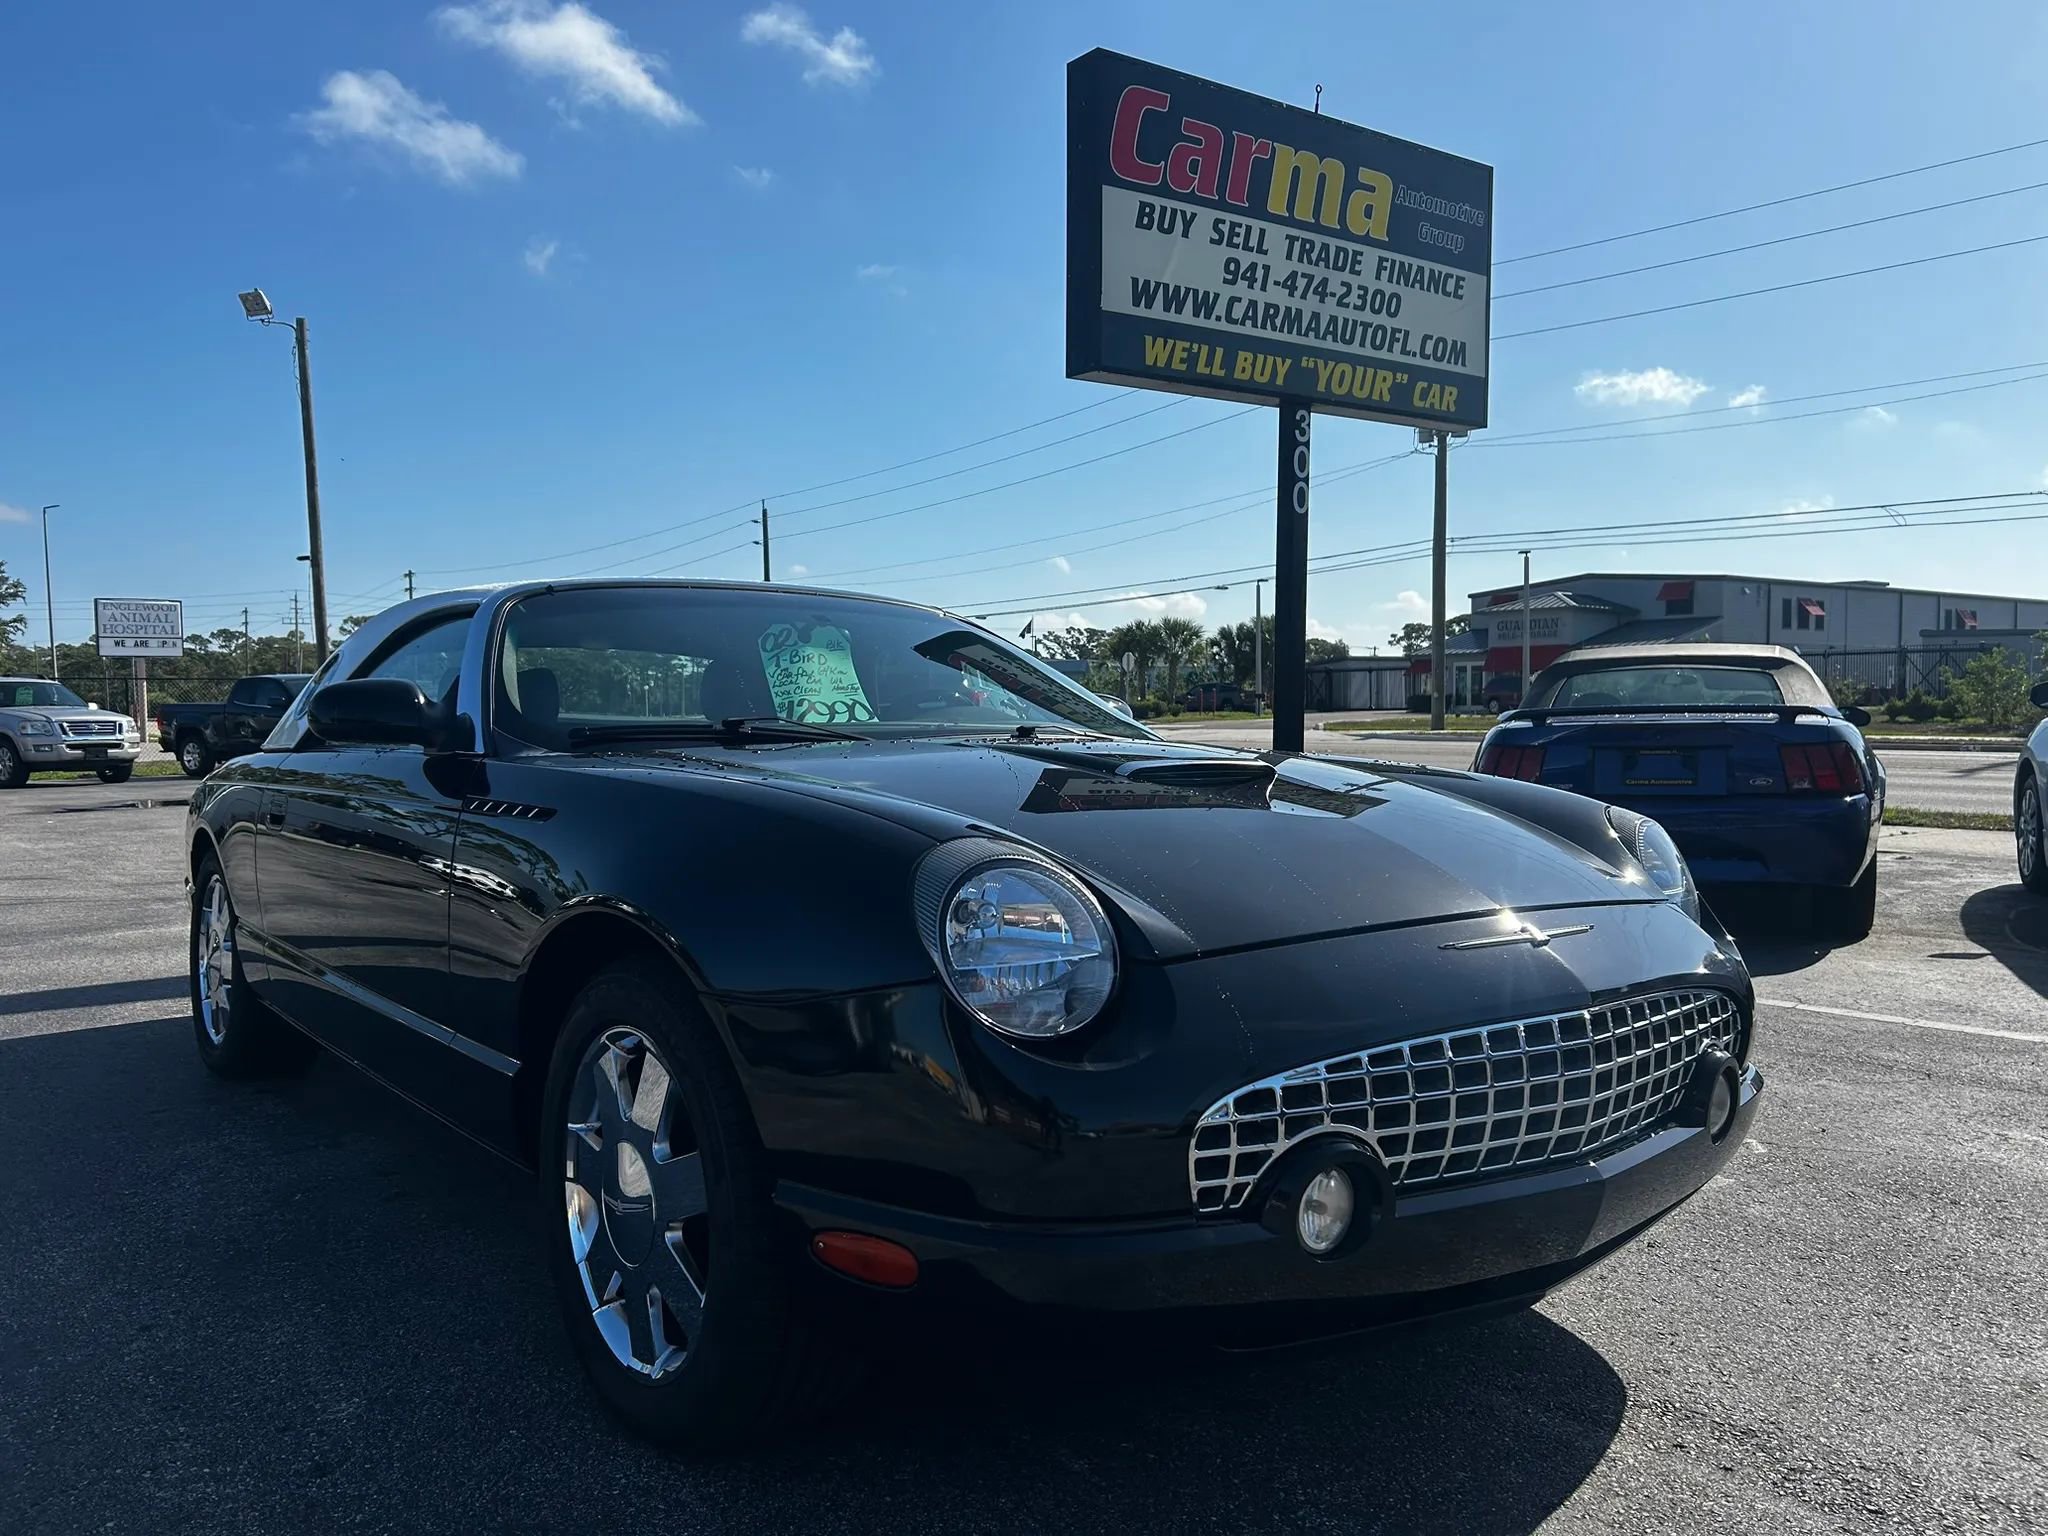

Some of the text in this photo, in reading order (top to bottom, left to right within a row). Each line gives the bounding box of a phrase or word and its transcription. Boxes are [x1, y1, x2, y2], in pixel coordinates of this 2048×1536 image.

[1109, 84, 1394, 242] Carma
[1395, 184, 1486, 227] Automotive
[1135, 200, 1467, 300] BUY SELL TRADE FINANCE
[1418, 222, 1465, 254] Group
[1222, 256, 1402, 319] 941-474-2300
[1130, 276, 1468, 367] WWW.CARMAAUTOFL.COM
[1143, 335, 1459, 412] WE'LL BUY "YOUR" CAR
[1293, 409, 1310, 514] 300
[102, 602, 177, 612] ENGLEWOOD
[107, 612, 173, 623] ANIMAL
[1497, 618, 1560, 631] GUADIAN
[102, 623, 179, 635] HOSPITAL
[114, 640, 126, 648] WE
[134, 640, 149, 648] ARE
[761, 627, 798, 652] 02
